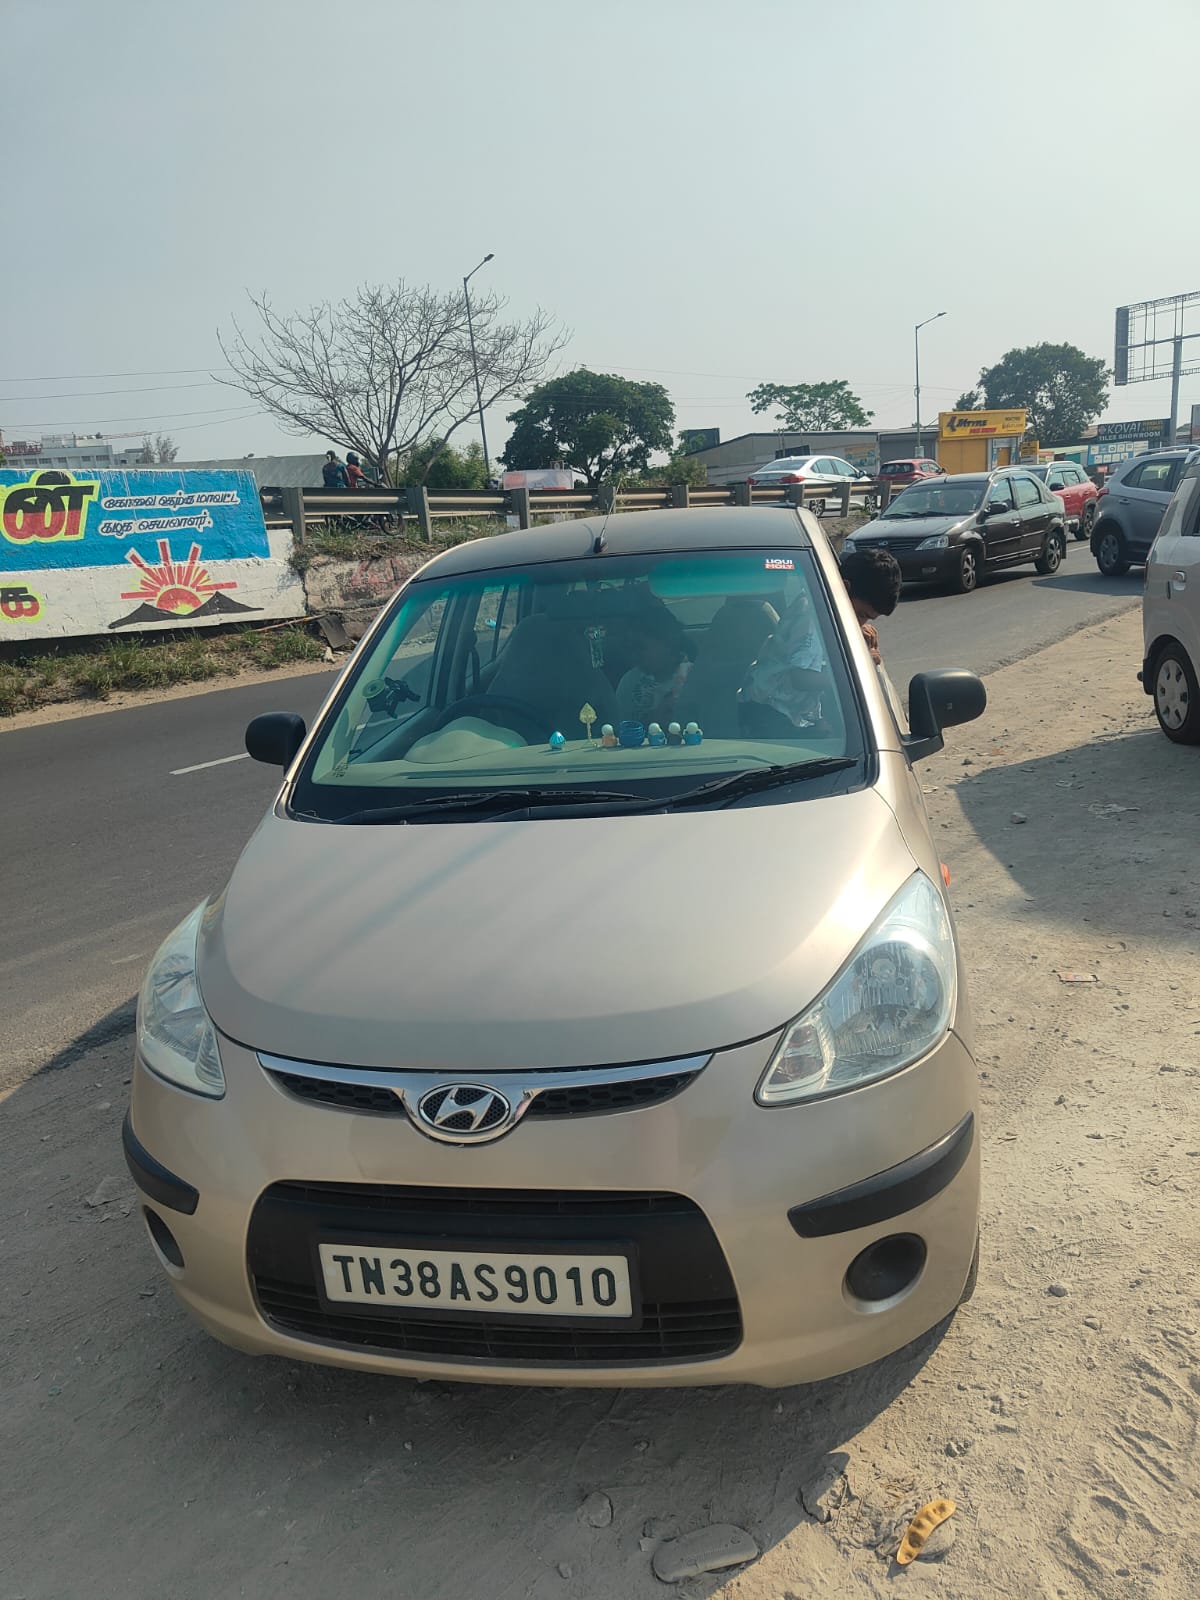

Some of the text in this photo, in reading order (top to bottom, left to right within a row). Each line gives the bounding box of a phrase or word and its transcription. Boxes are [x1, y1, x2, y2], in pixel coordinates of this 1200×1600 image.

[1107, 423, 1141, 434] KOVAI
[1118, 431, 1161, 440] SHOWROOM
[100, 520, 133, 537] கழக
[332, 1254, 618, 1307] TN38AS9010
